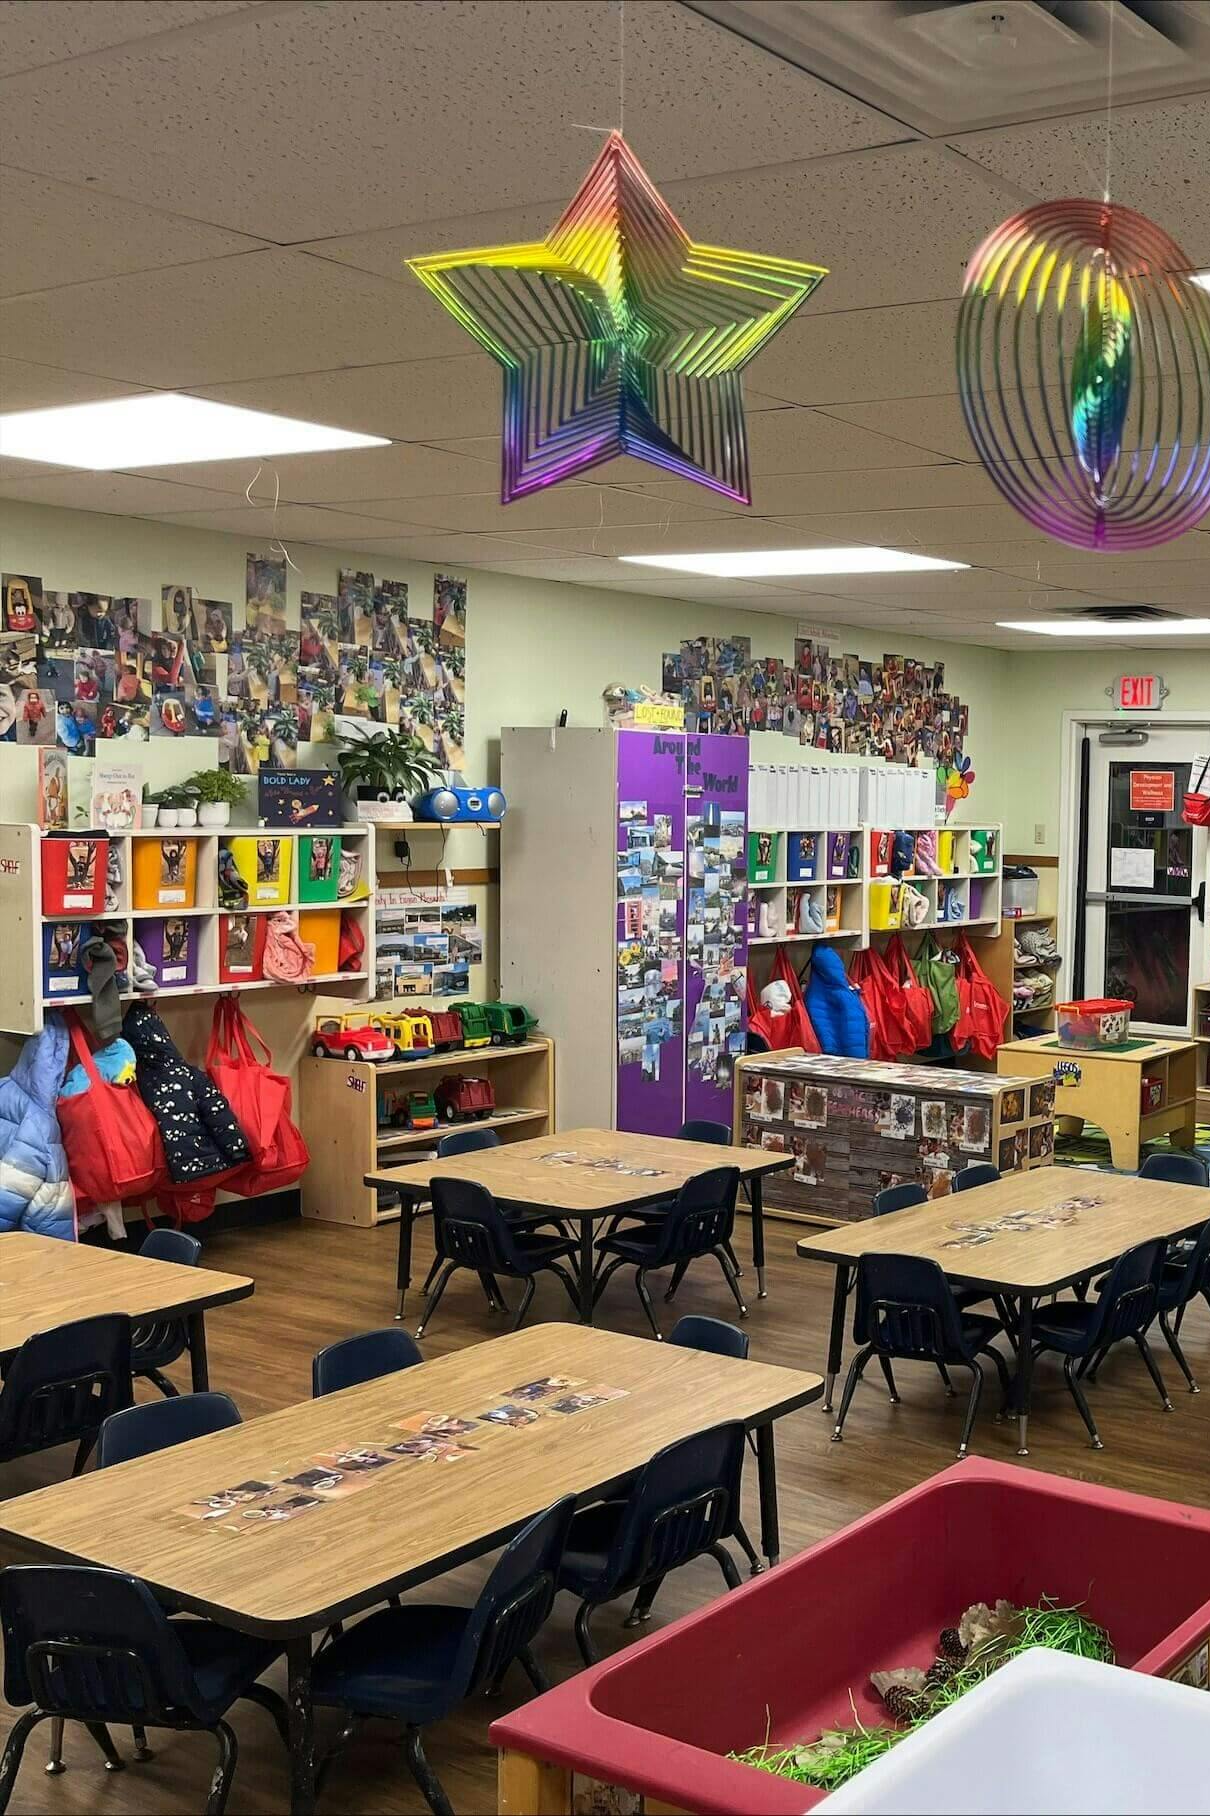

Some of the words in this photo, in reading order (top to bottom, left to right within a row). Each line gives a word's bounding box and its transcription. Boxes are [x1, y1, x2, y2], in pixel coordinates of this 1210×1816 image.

[1121, 678, 1153, 706] EXIT
[653, 736, 701, 756] Around
[675, 756, 701, 775] The
[263, 776, 286, 785] BOLD
[289, 776, 311, 785] LADY
[703, 772, 739, 793] World
